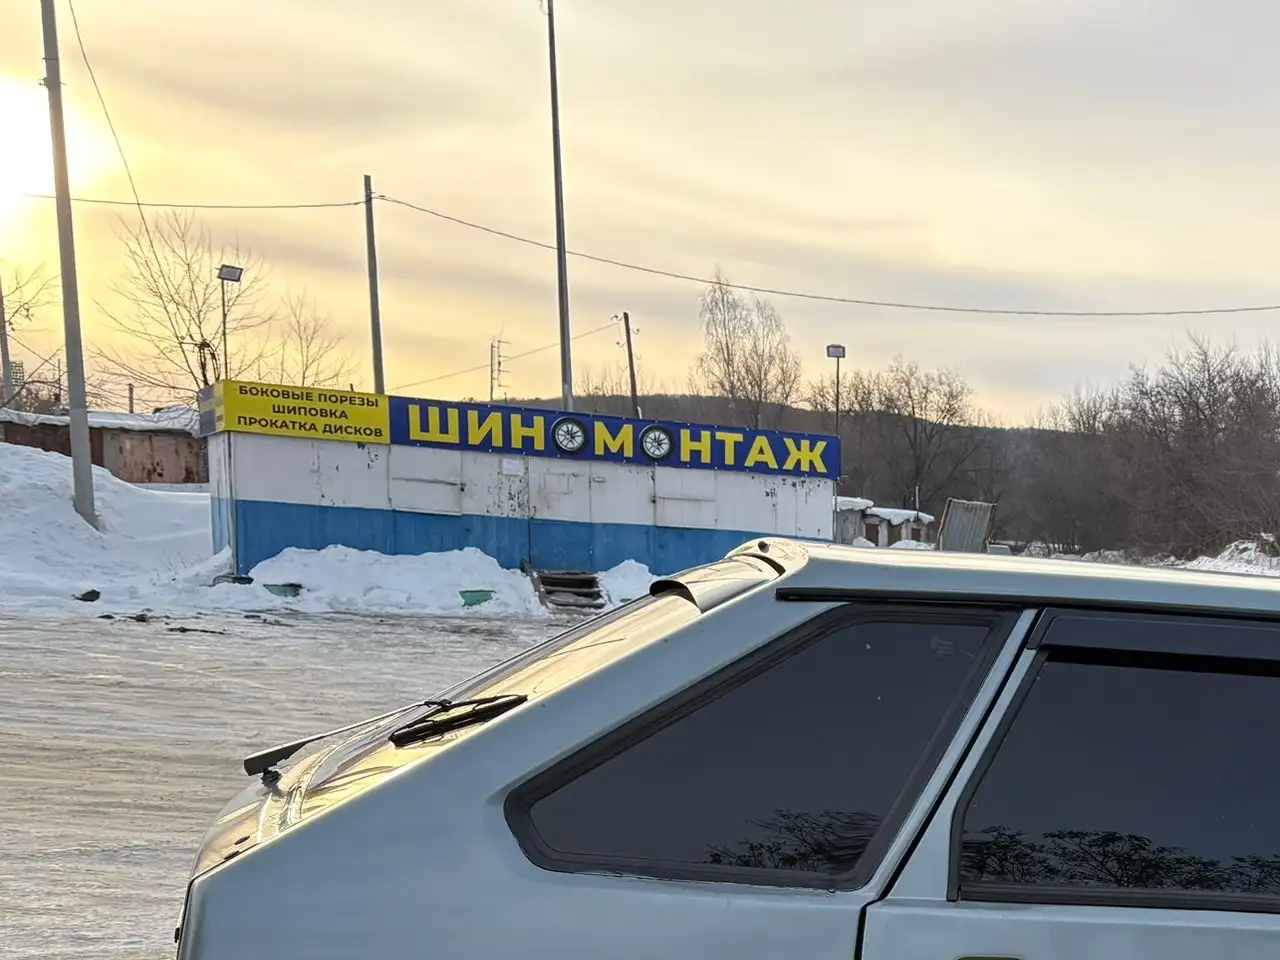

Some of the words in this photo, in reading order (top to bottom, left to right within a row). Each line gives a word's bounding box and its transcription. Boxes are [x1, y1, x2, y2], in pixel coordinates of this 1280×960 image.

[238, 385, 314, 402] БОКОВЫЕ
[318, 393, 379, 408] ПОРЕЗЫ
[271, 404, 349, 420] ШИПОВКА
[237, 415, 319, 433] ПРОКАТКА
[322, 423, 384, 438] ДИСКОВ
